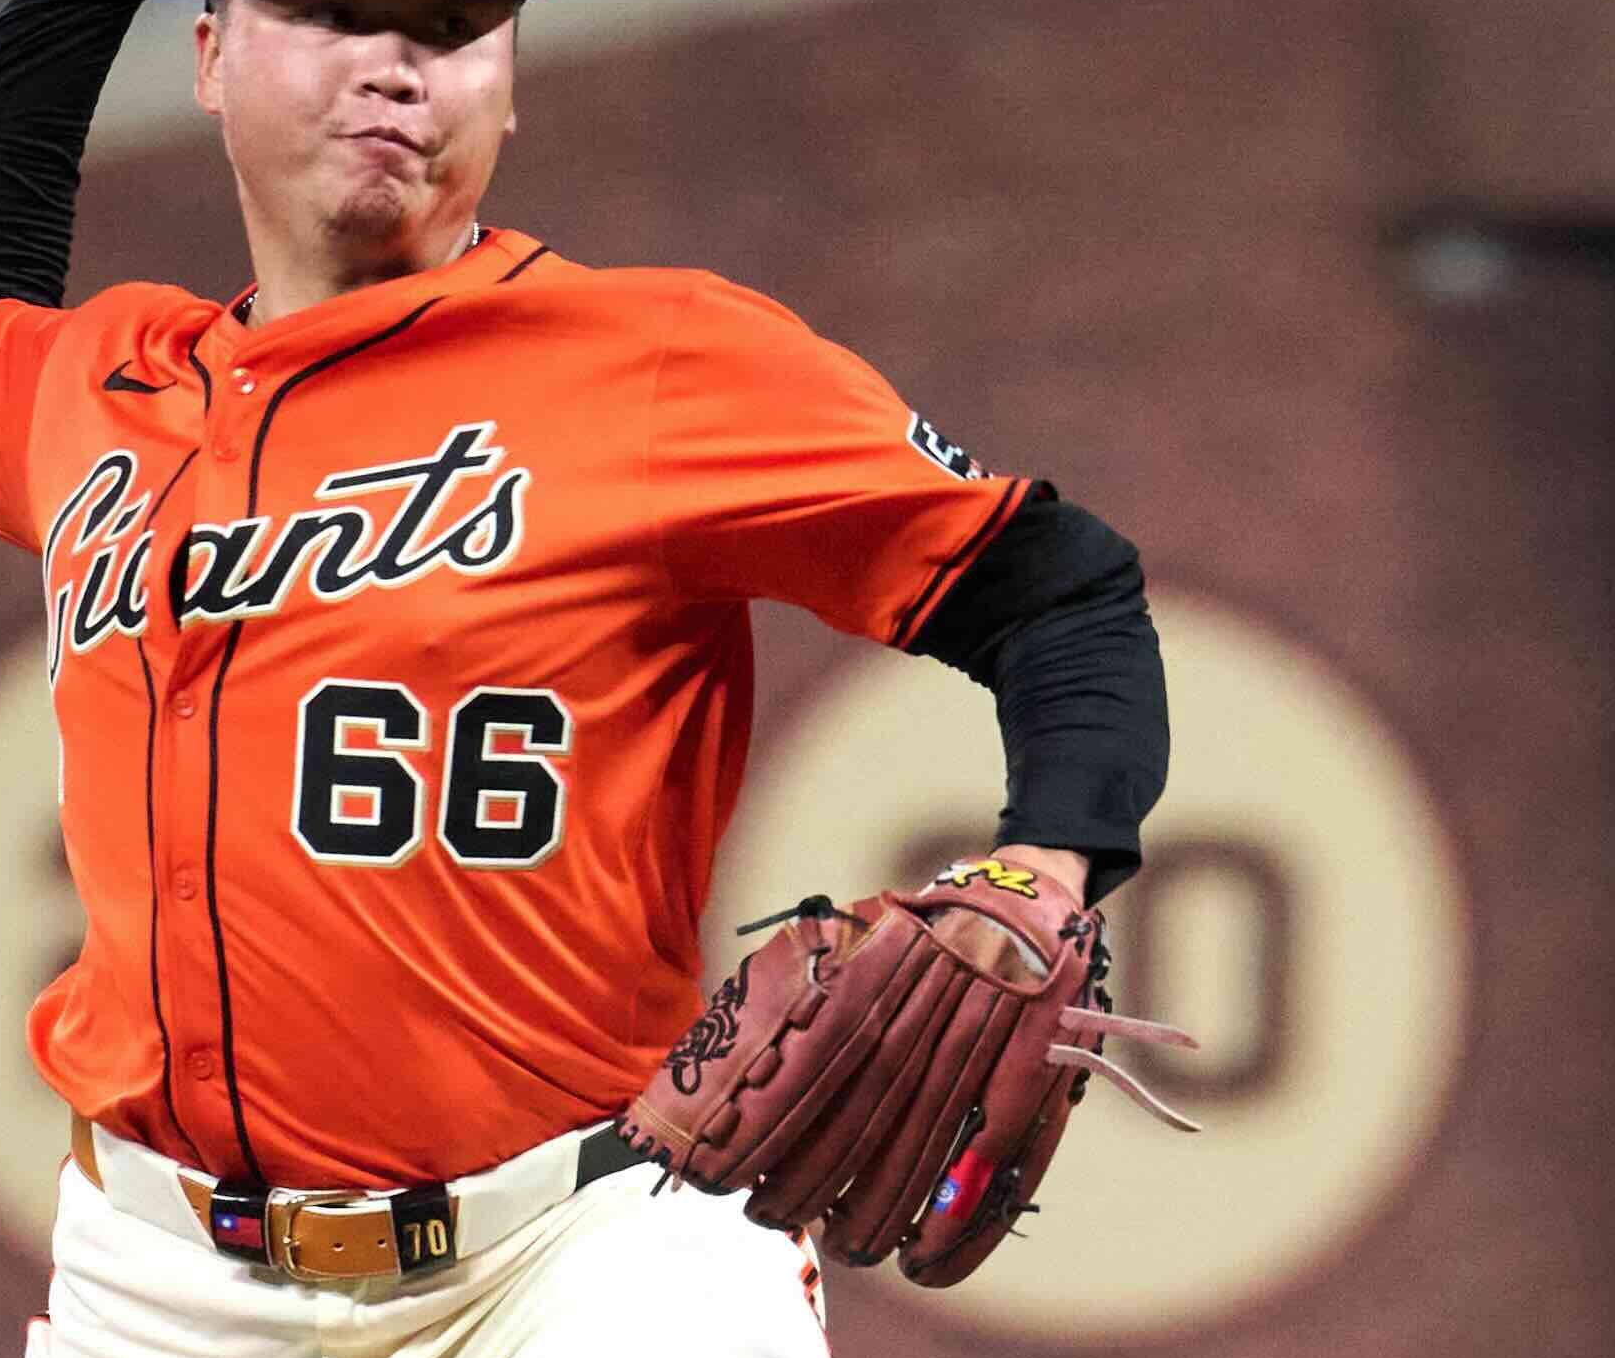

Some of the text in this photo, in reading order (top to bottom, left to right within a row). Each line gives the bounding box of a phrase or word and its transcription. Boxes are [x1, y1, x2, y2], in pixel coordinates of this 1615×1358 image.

[41, 419, 532, 690] Giants
[289, 677, 574, 869] 66
[402, 1219, 448, 1260] 70
